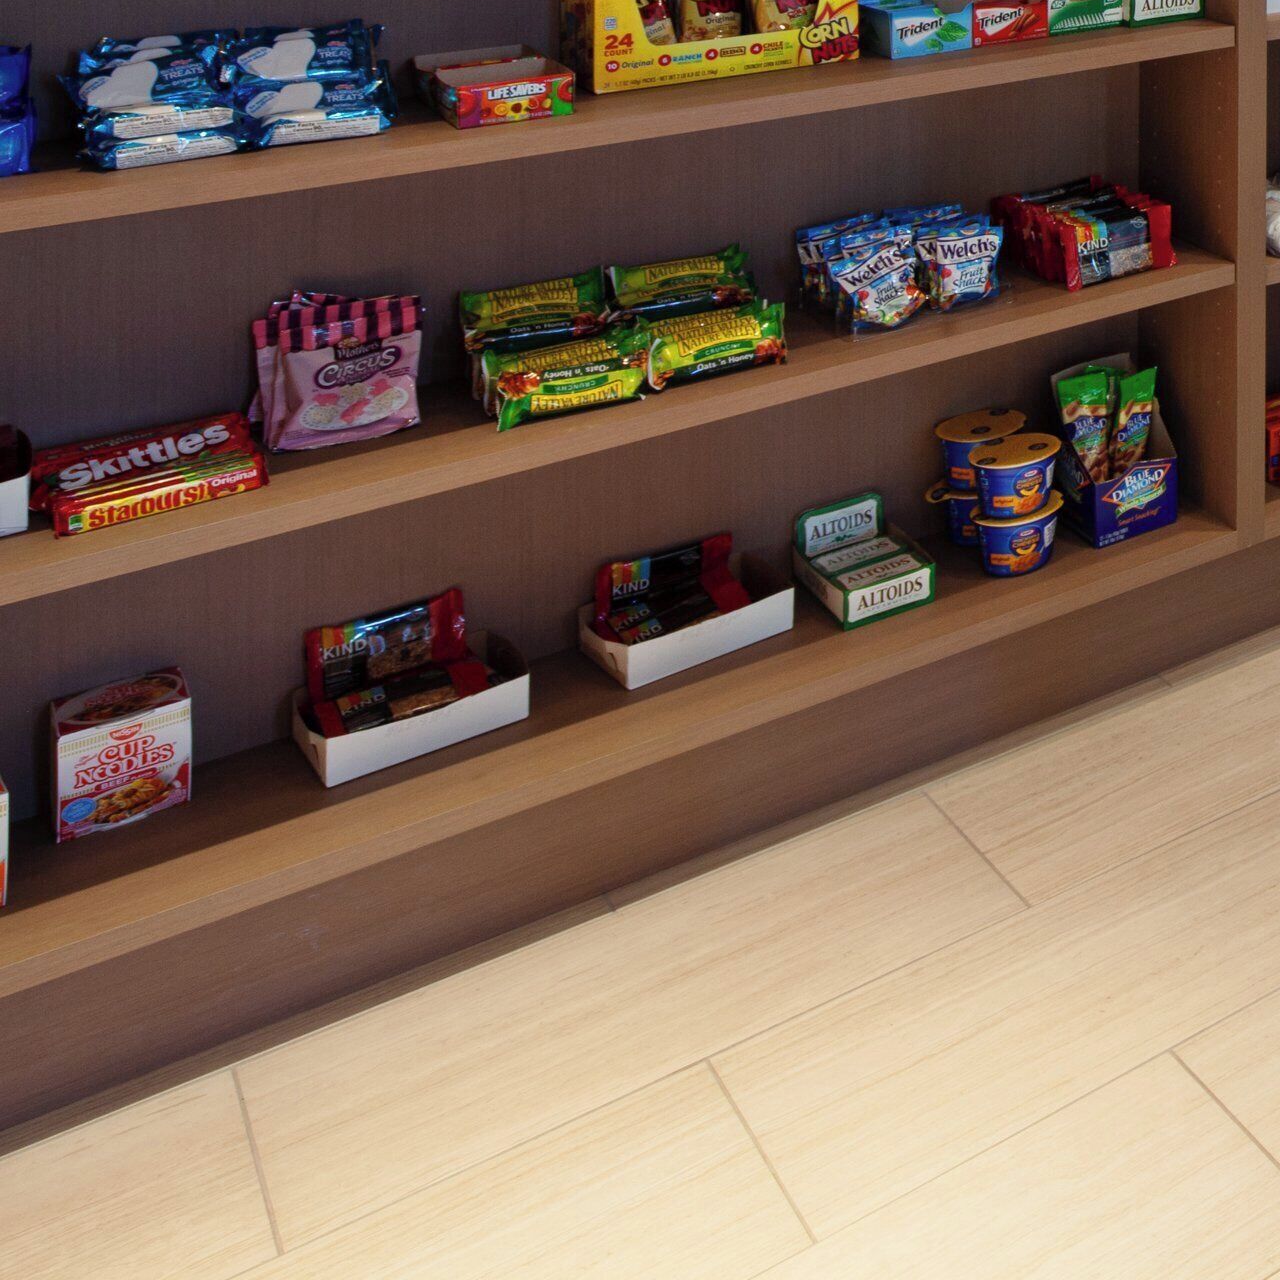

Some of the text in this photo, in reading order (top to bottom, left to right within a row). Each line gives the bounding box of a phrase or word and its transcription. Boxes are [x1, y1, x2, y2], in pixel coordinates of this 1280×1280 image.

[978, 8, 1021, 29] Trident
[799, 17, 849, 47] CORN
[898, 16, 942, 41] Trident
[605, 33, 634, 49] 24
[604, 49, 633, 57] COUNT
[621, 59, 653, 68] Original
[941, 240, 996, 258] Welch's
[1078, 239, 1108, 252] KIND
[844, 249, 902, 287] Welch's
[697, 353, 754, 371] Oats Honey
[59, 424, 229, 490] Skittles
[211, 469, 258, 487] Original
[88, 482, 209, 528] Starburst
[810, 510, 872, 540] ALTOIDS
[612, 579, 650, 595] KIND
[858, 578, 922, 611] ALTOIDS
[324, 640, 366, 659] KIND
